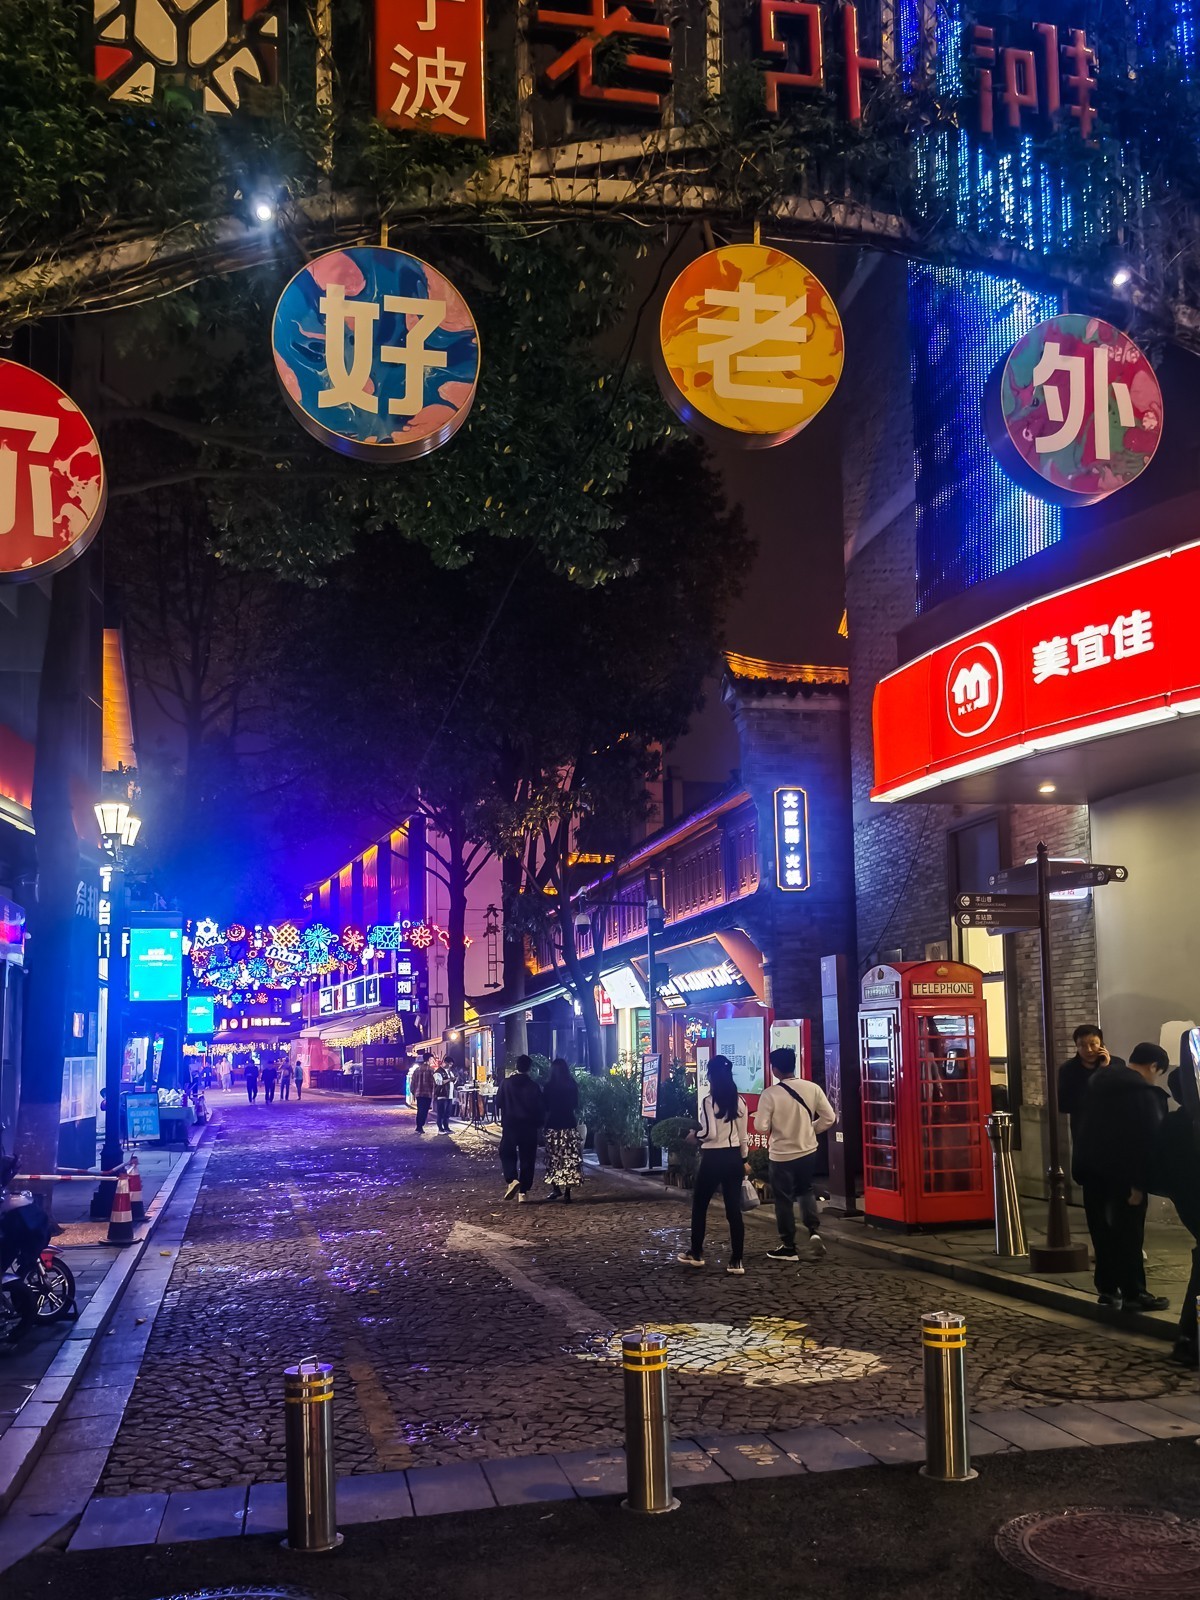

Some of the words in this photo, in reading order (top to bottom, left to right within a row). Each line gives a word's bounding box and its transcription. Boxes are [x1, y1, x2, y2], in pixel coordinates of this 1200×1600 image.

[317, 283, 448, 416] 好
[696, 281, 808, 405] 老
[1032, 342, 1135, 461] 外
[1031, 608, 1155, 685] 美宜佳
[913, 983, 973, 994] TELEPHONE
